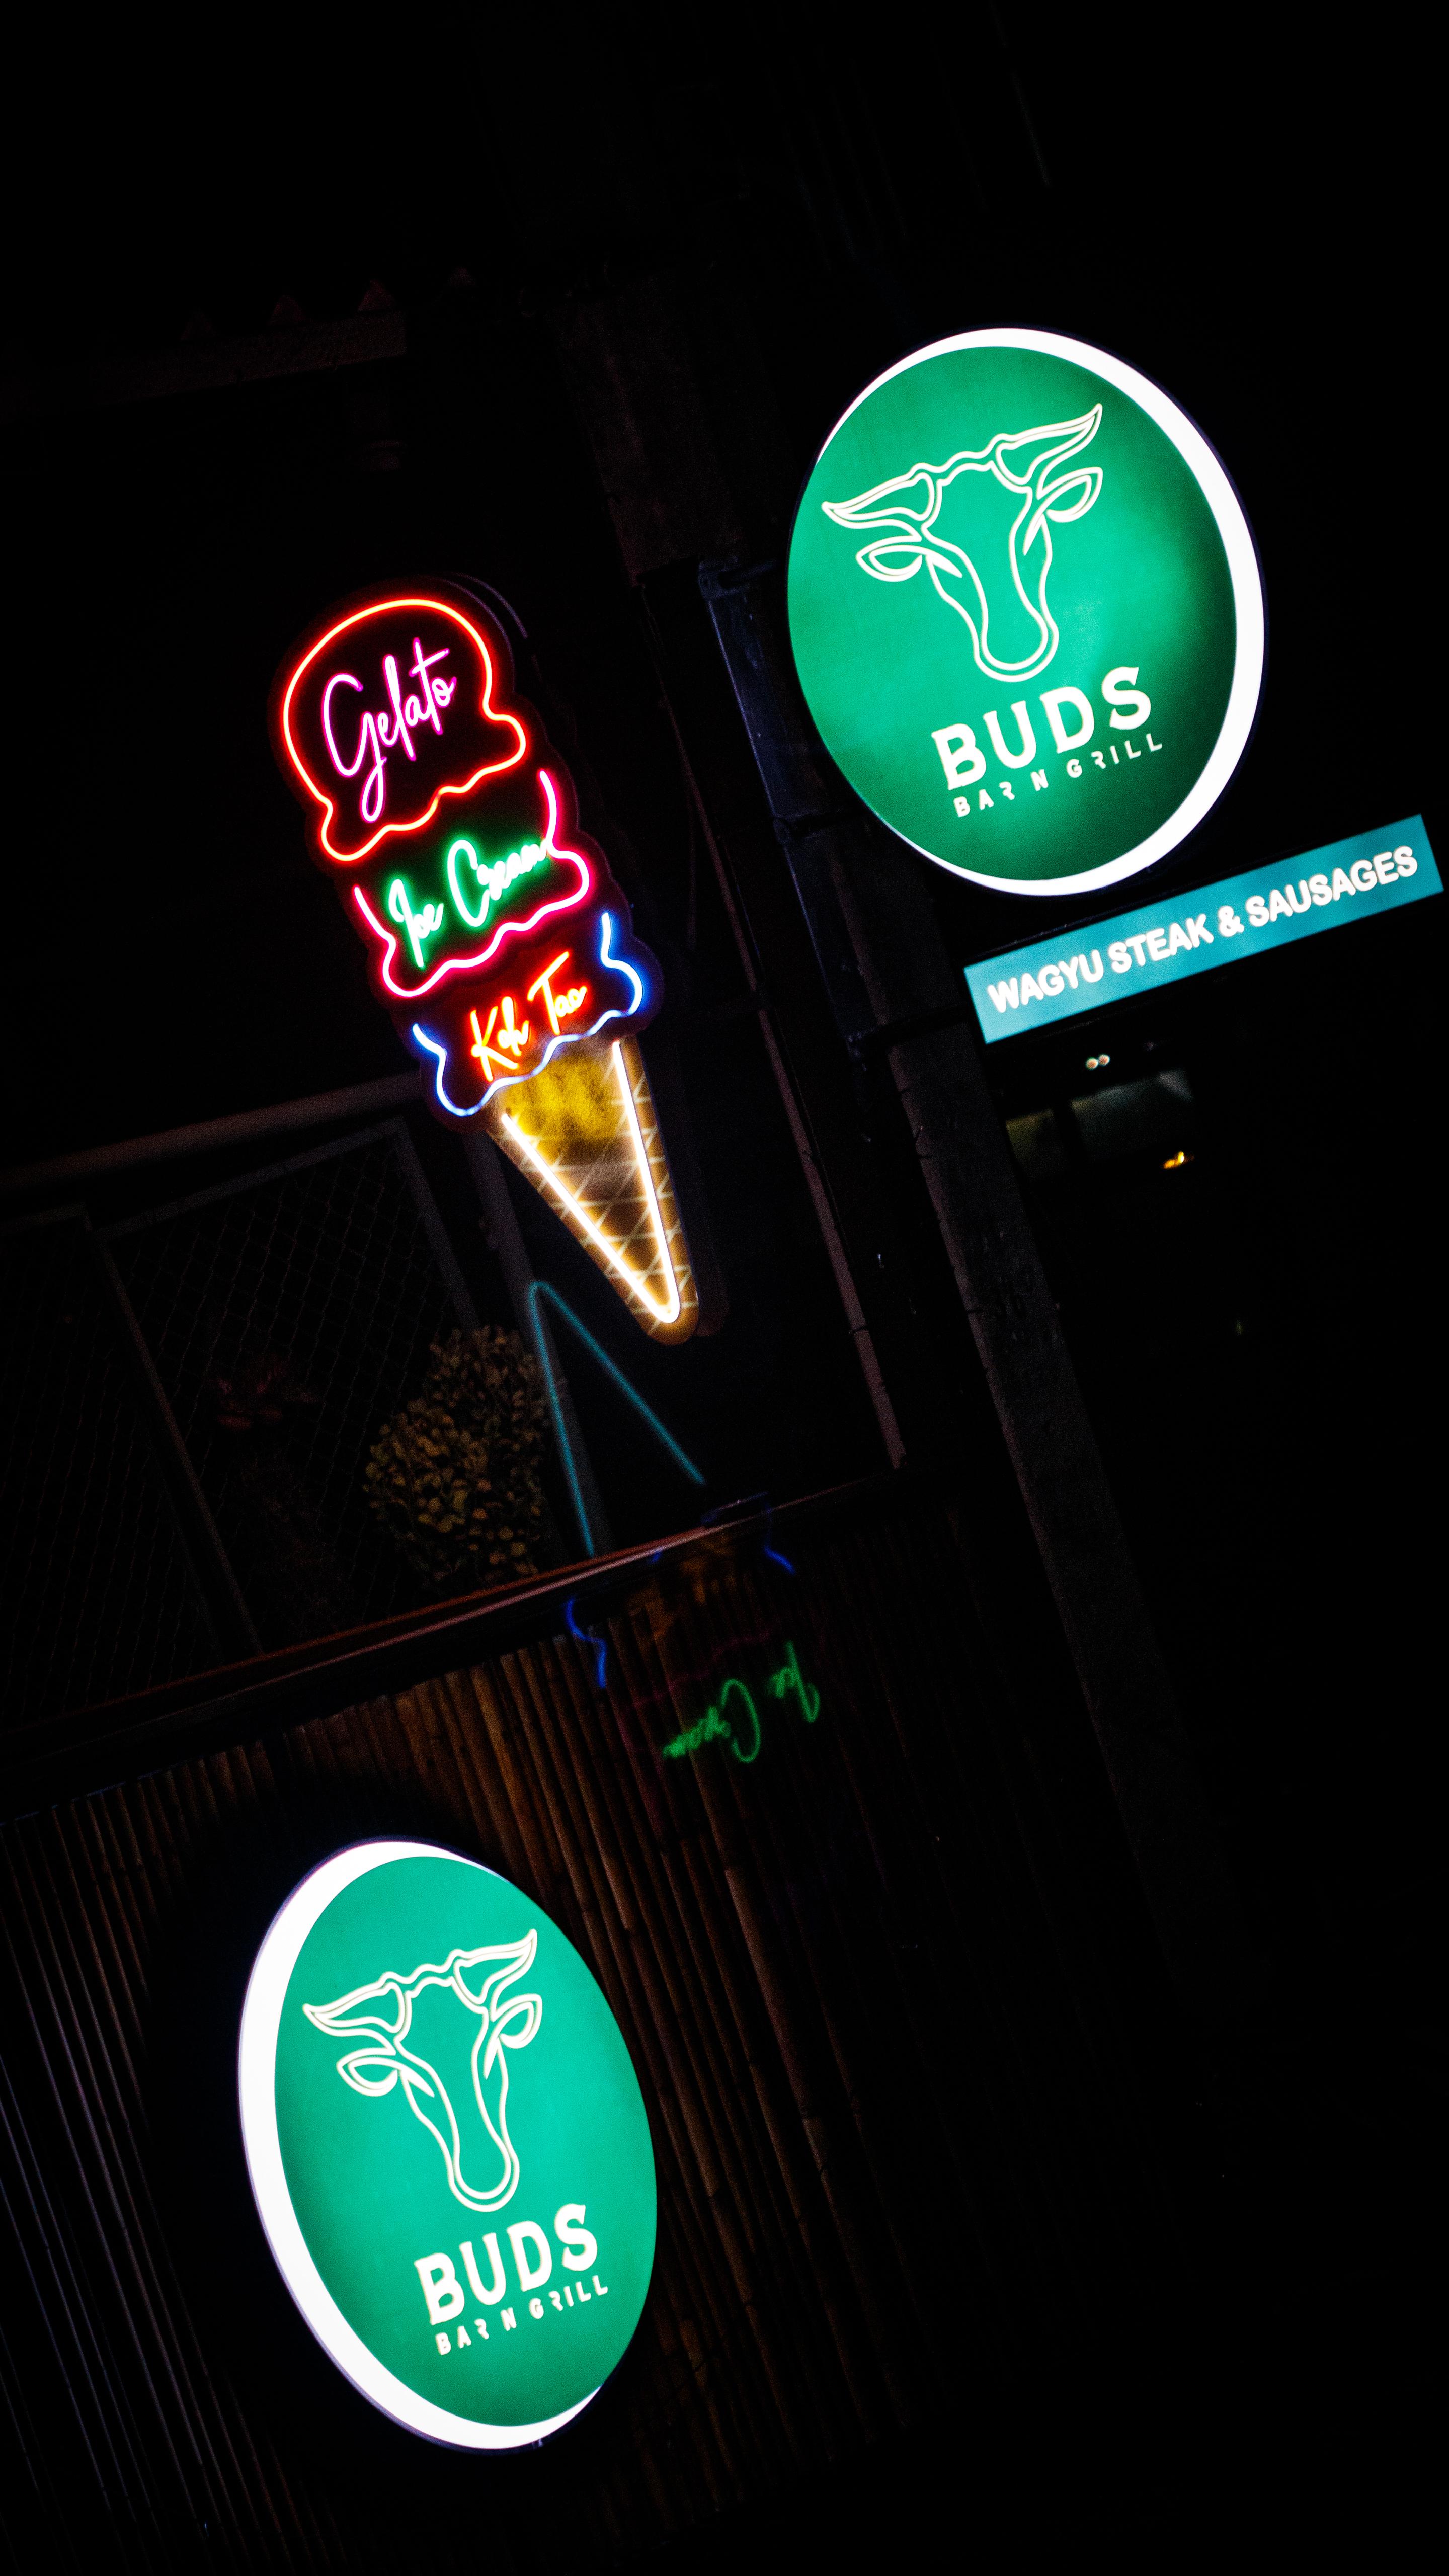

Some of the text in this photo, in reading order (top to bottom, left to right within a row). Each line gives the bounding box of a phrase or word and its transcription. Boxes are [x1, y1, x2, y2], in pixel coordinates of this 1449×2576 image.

[322, 637, 457, 822] Gelato
[931, 666, 1152, 791] BUDS
[953, 733, 1163, 817] BAR N GRILL
[388, 839, 548, 968] Ice Cream
[987, 845, 1418, 1014] WAGYU STEAK & SAUSAGES
[471, 951, 587, 1082] Koh Tao
[414, 2203, 598, 2326] BUDS
[435, 2274, 608, 2356] BAR N GRILL
